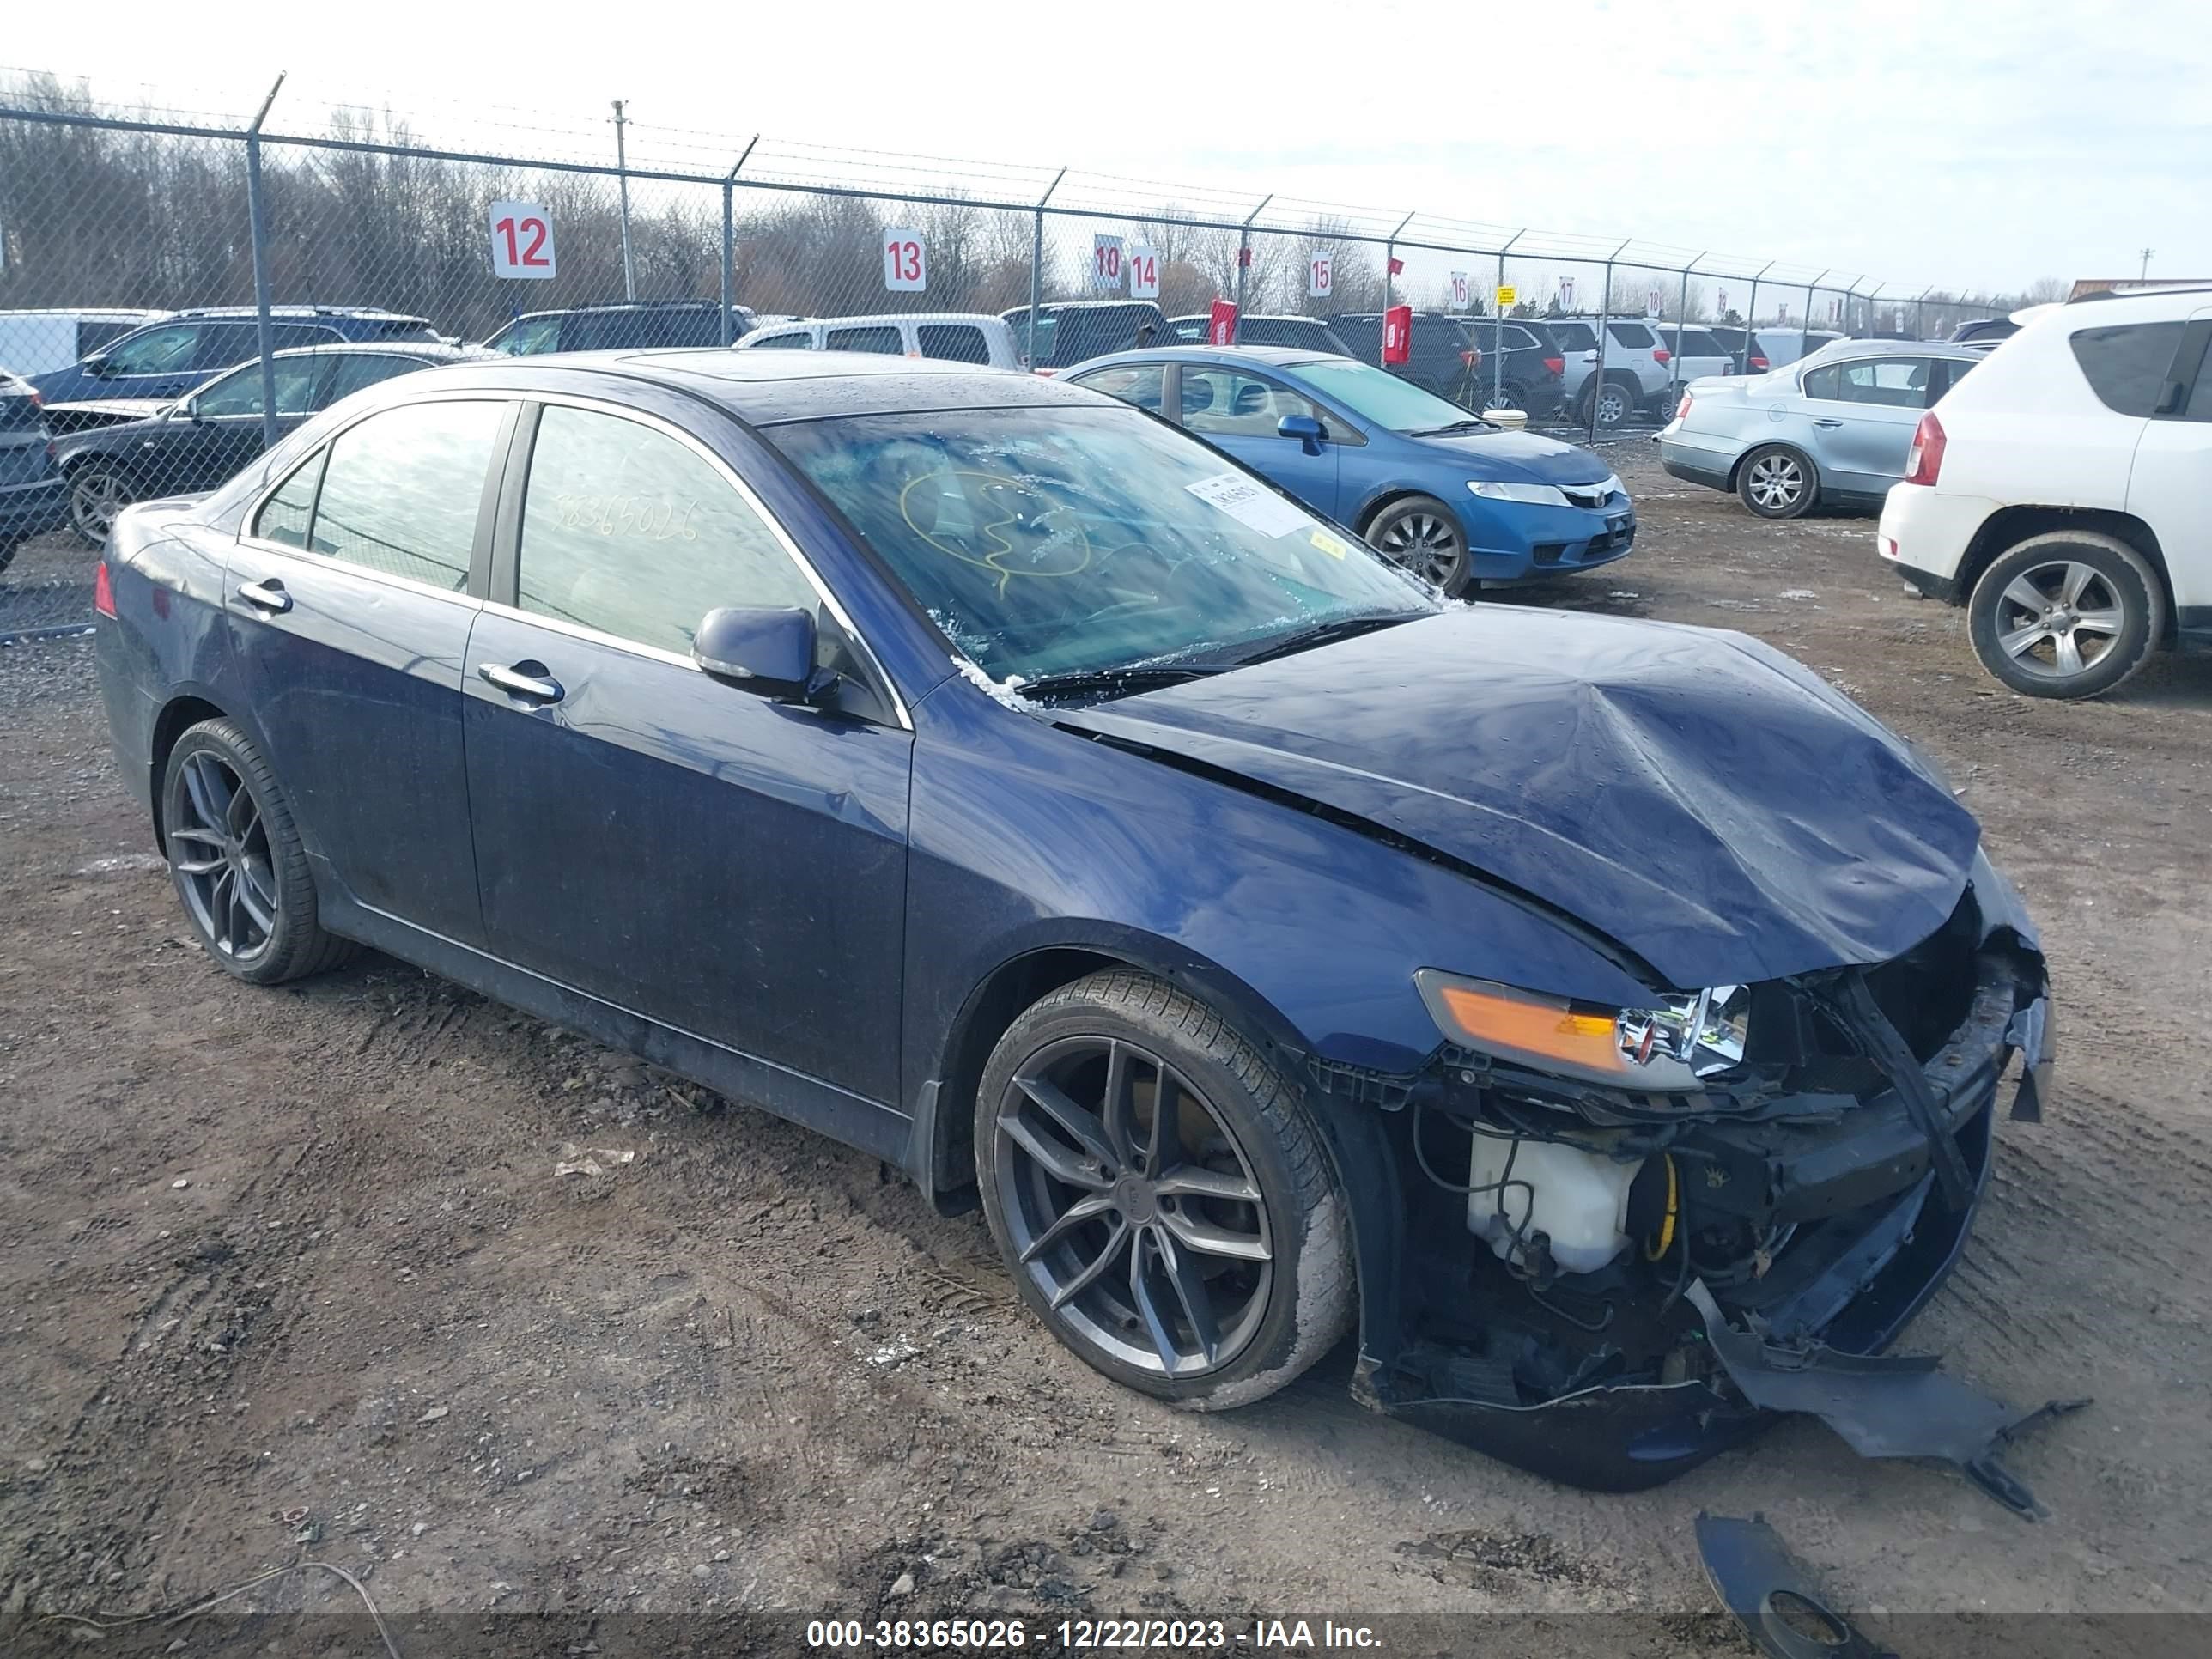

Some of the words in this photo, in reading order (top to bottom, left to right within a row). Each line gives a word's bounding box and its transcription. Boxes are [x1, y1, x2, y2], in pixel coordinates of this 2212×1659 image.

[495, 217, 550, 266] 12
[888, 241, 921, 281] 13
[1097, 246, 1120, 277] 10
[1133, 256, 1157, 289] 14
[1312, 260, 1329, 289] 15
[1452, 277, 1467, 303] 16
[1560, 283, 1573, 304] 17
[1649, 291, 1660, 312] 18
